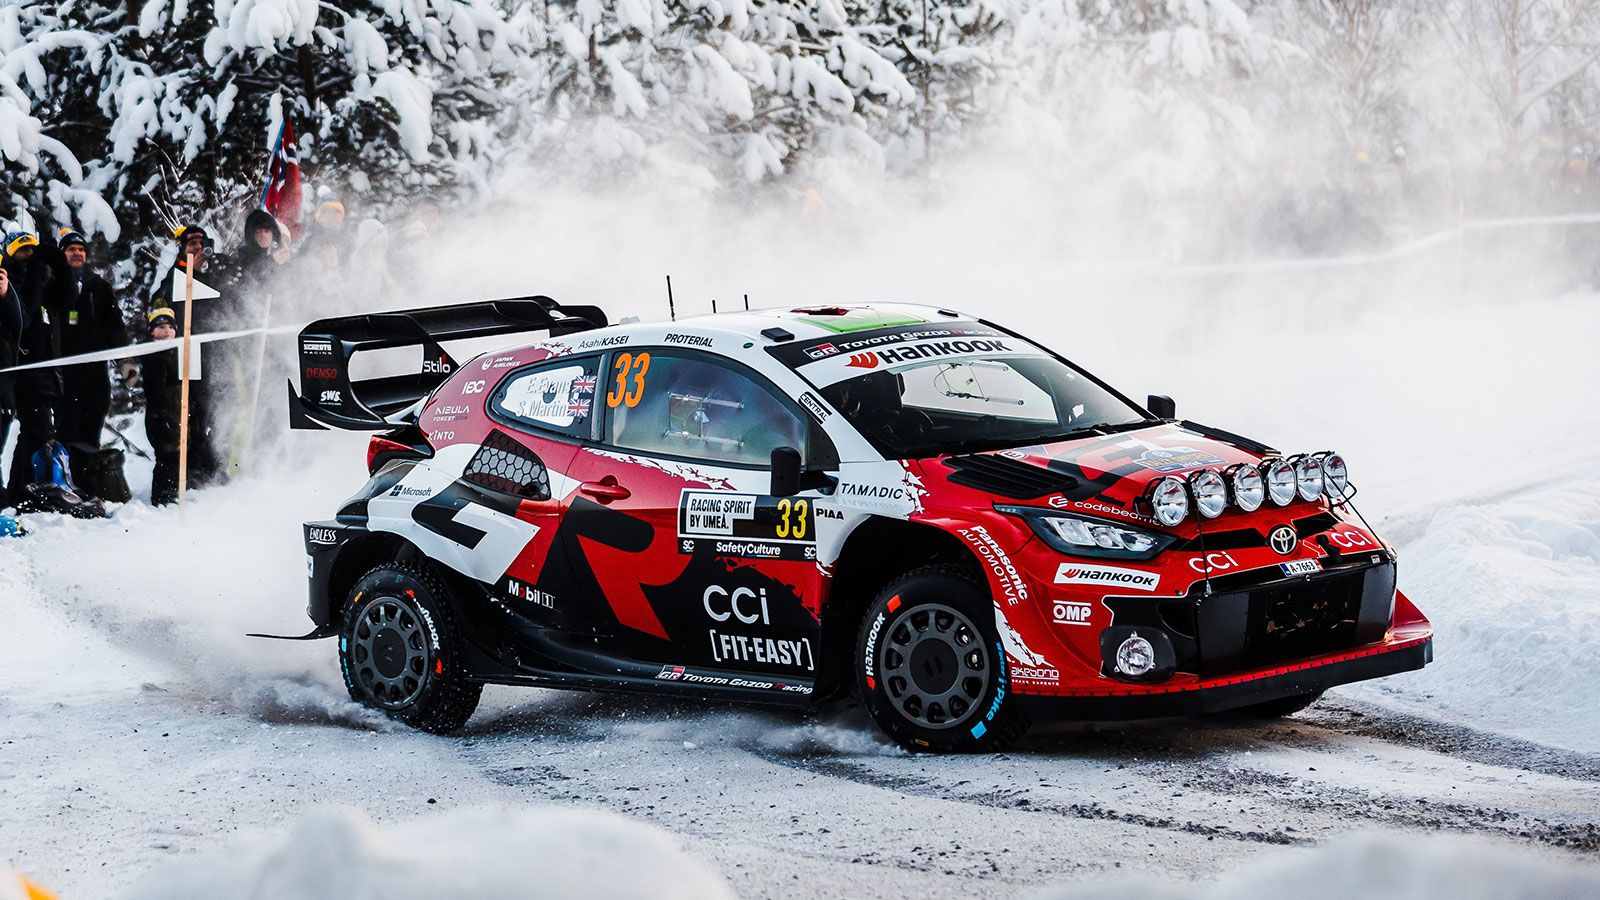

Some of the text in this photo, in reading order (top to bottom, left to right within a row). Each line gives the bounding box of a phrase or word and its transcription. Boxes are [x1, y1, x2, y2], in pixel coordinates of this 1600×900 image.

[664, 333, 714, 348] PROTERIAL
[809, 344, 840, 360] GR
[839, 334, 899, 350] TOYOTA
[423, 354, 451, 373] Stilo
[305, 367, 338, 379] DENSO
[606, 352, 651, 408] 33
[320, 390, 343, 402] SWS
[800, 393, 827, 421] CENTRAL
[402, 485, 432, 497] Microsoft
[841, 483, 904, 500] TAMADIC
[689, 498, 752, 515] RACING SPIRIT
[815, 507, 844, 520] PIAA
[689, 514, 729, 530] BY UMEÅ.
[775, 498, 808, 539] 33
[309, 528, 337, 542] ENDLESS
[682, 540, 695, 551] SC
[716, 541, 781, 556] SafetyCulture
[804, 547, 816, 558] SC
[956, 529, 1019, 606] AUTOMOTIVE
[970, 525, 1028, 600] Panasonic
[1290, 561, 1316, 574] A-7663
[508, 580, 541, 604] Mobil
[1053, 604, 1092, 622] OMP
[1011, 666, 1060, 678] akebono
[658, 671, 813, 695] GR TOYOTA GAZOO Racing
